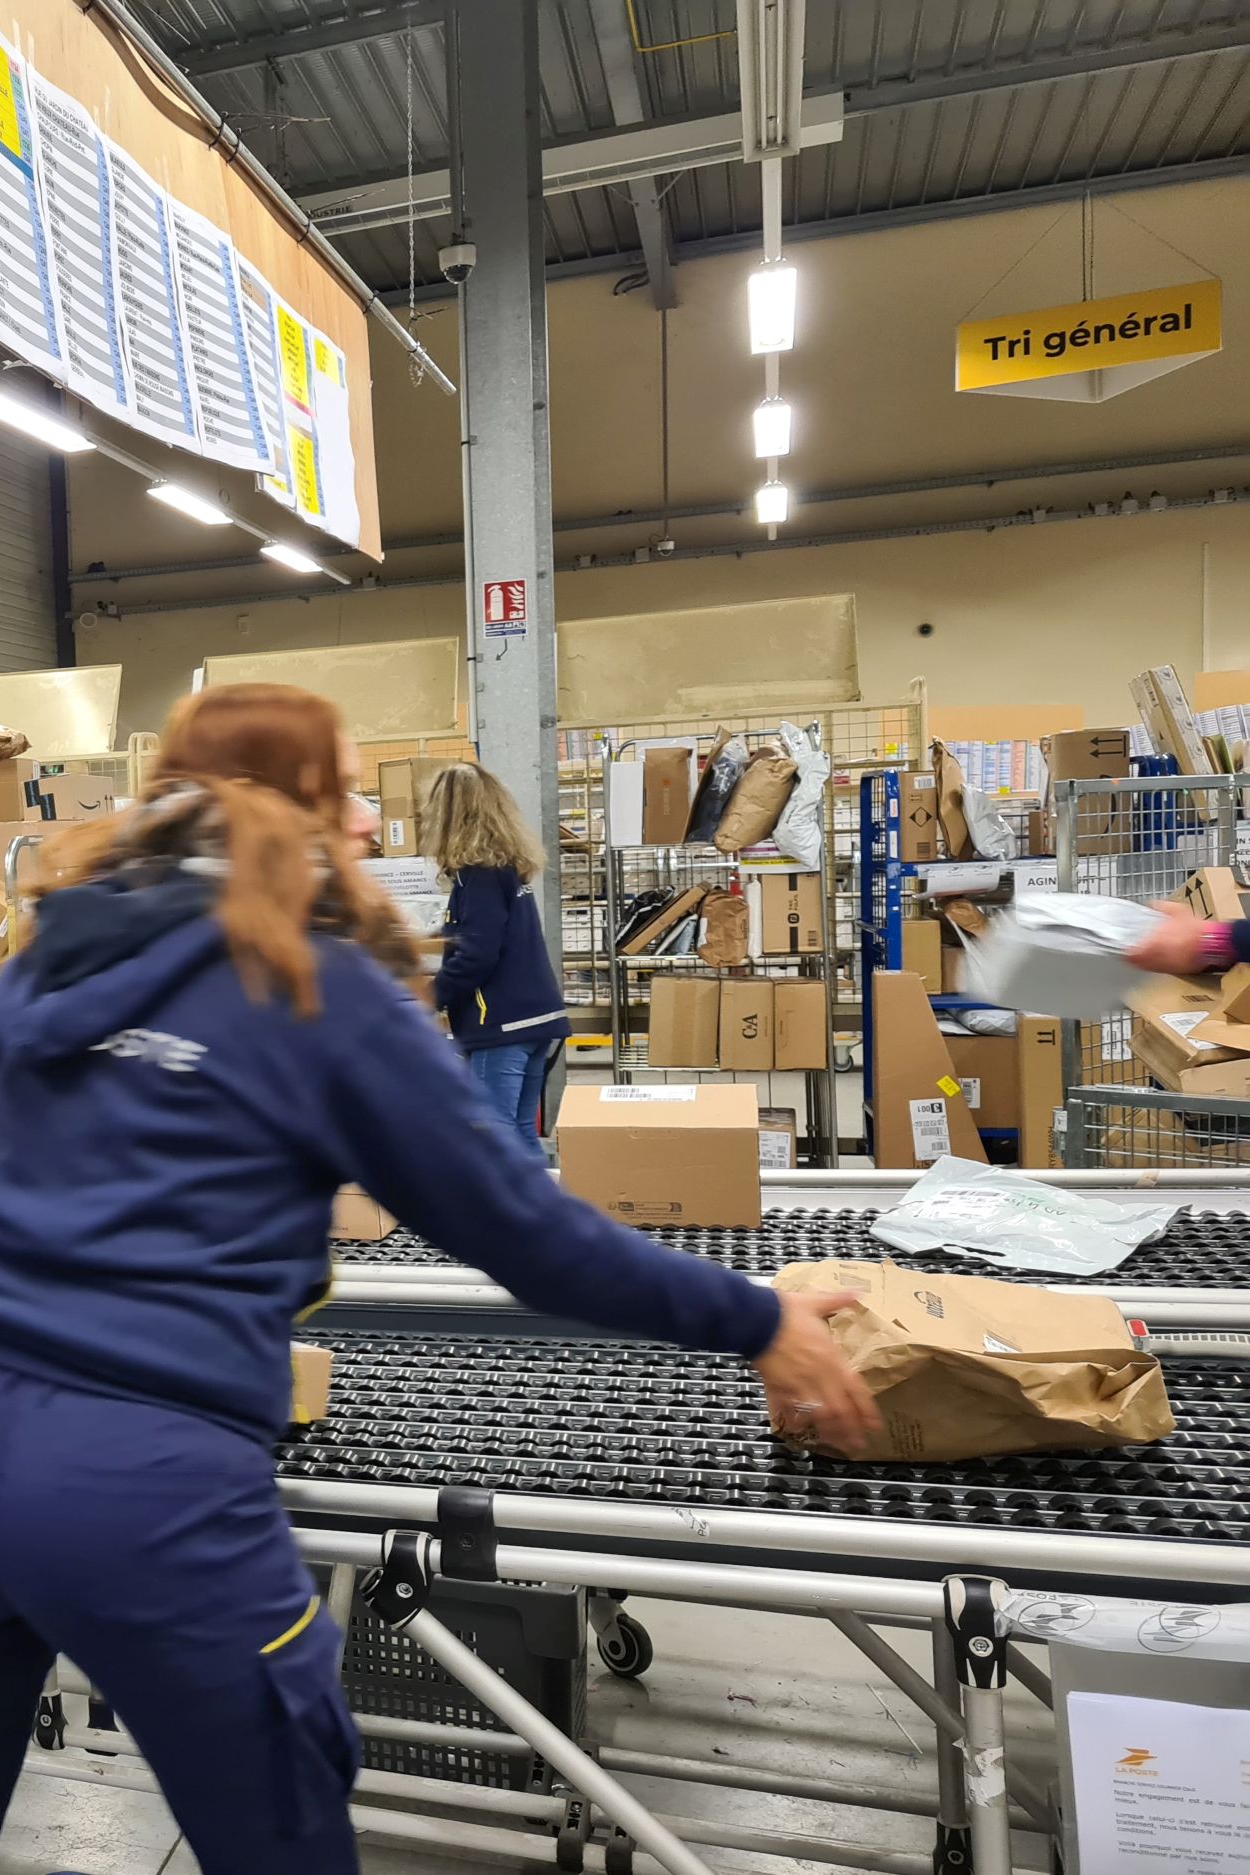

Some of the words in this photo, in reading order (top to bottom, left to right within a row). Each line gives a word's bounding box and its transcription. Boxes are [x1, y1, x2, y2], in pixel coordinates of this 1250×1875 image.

[984, 329, 1031, 361] Tri
[1043, 303, 1192, 357] général
[1129, 1768, 1159, 1776] POSTE
[1113, 1789, 1134, 1797] Notre
[1138, 1792, 1184, 1802] engagement
[1115, 1812, 1144, 1821] Lorsque
[1116, 1819, 1157, 1829] traitement,
[1179, 1826, 1205, 1834] tenons
[1117, 1826, 1157, 1835] conditions.
[1138, 1843, 1171, 1851] pourquoi
[1195, 1849, 1224, 1857] recevez
